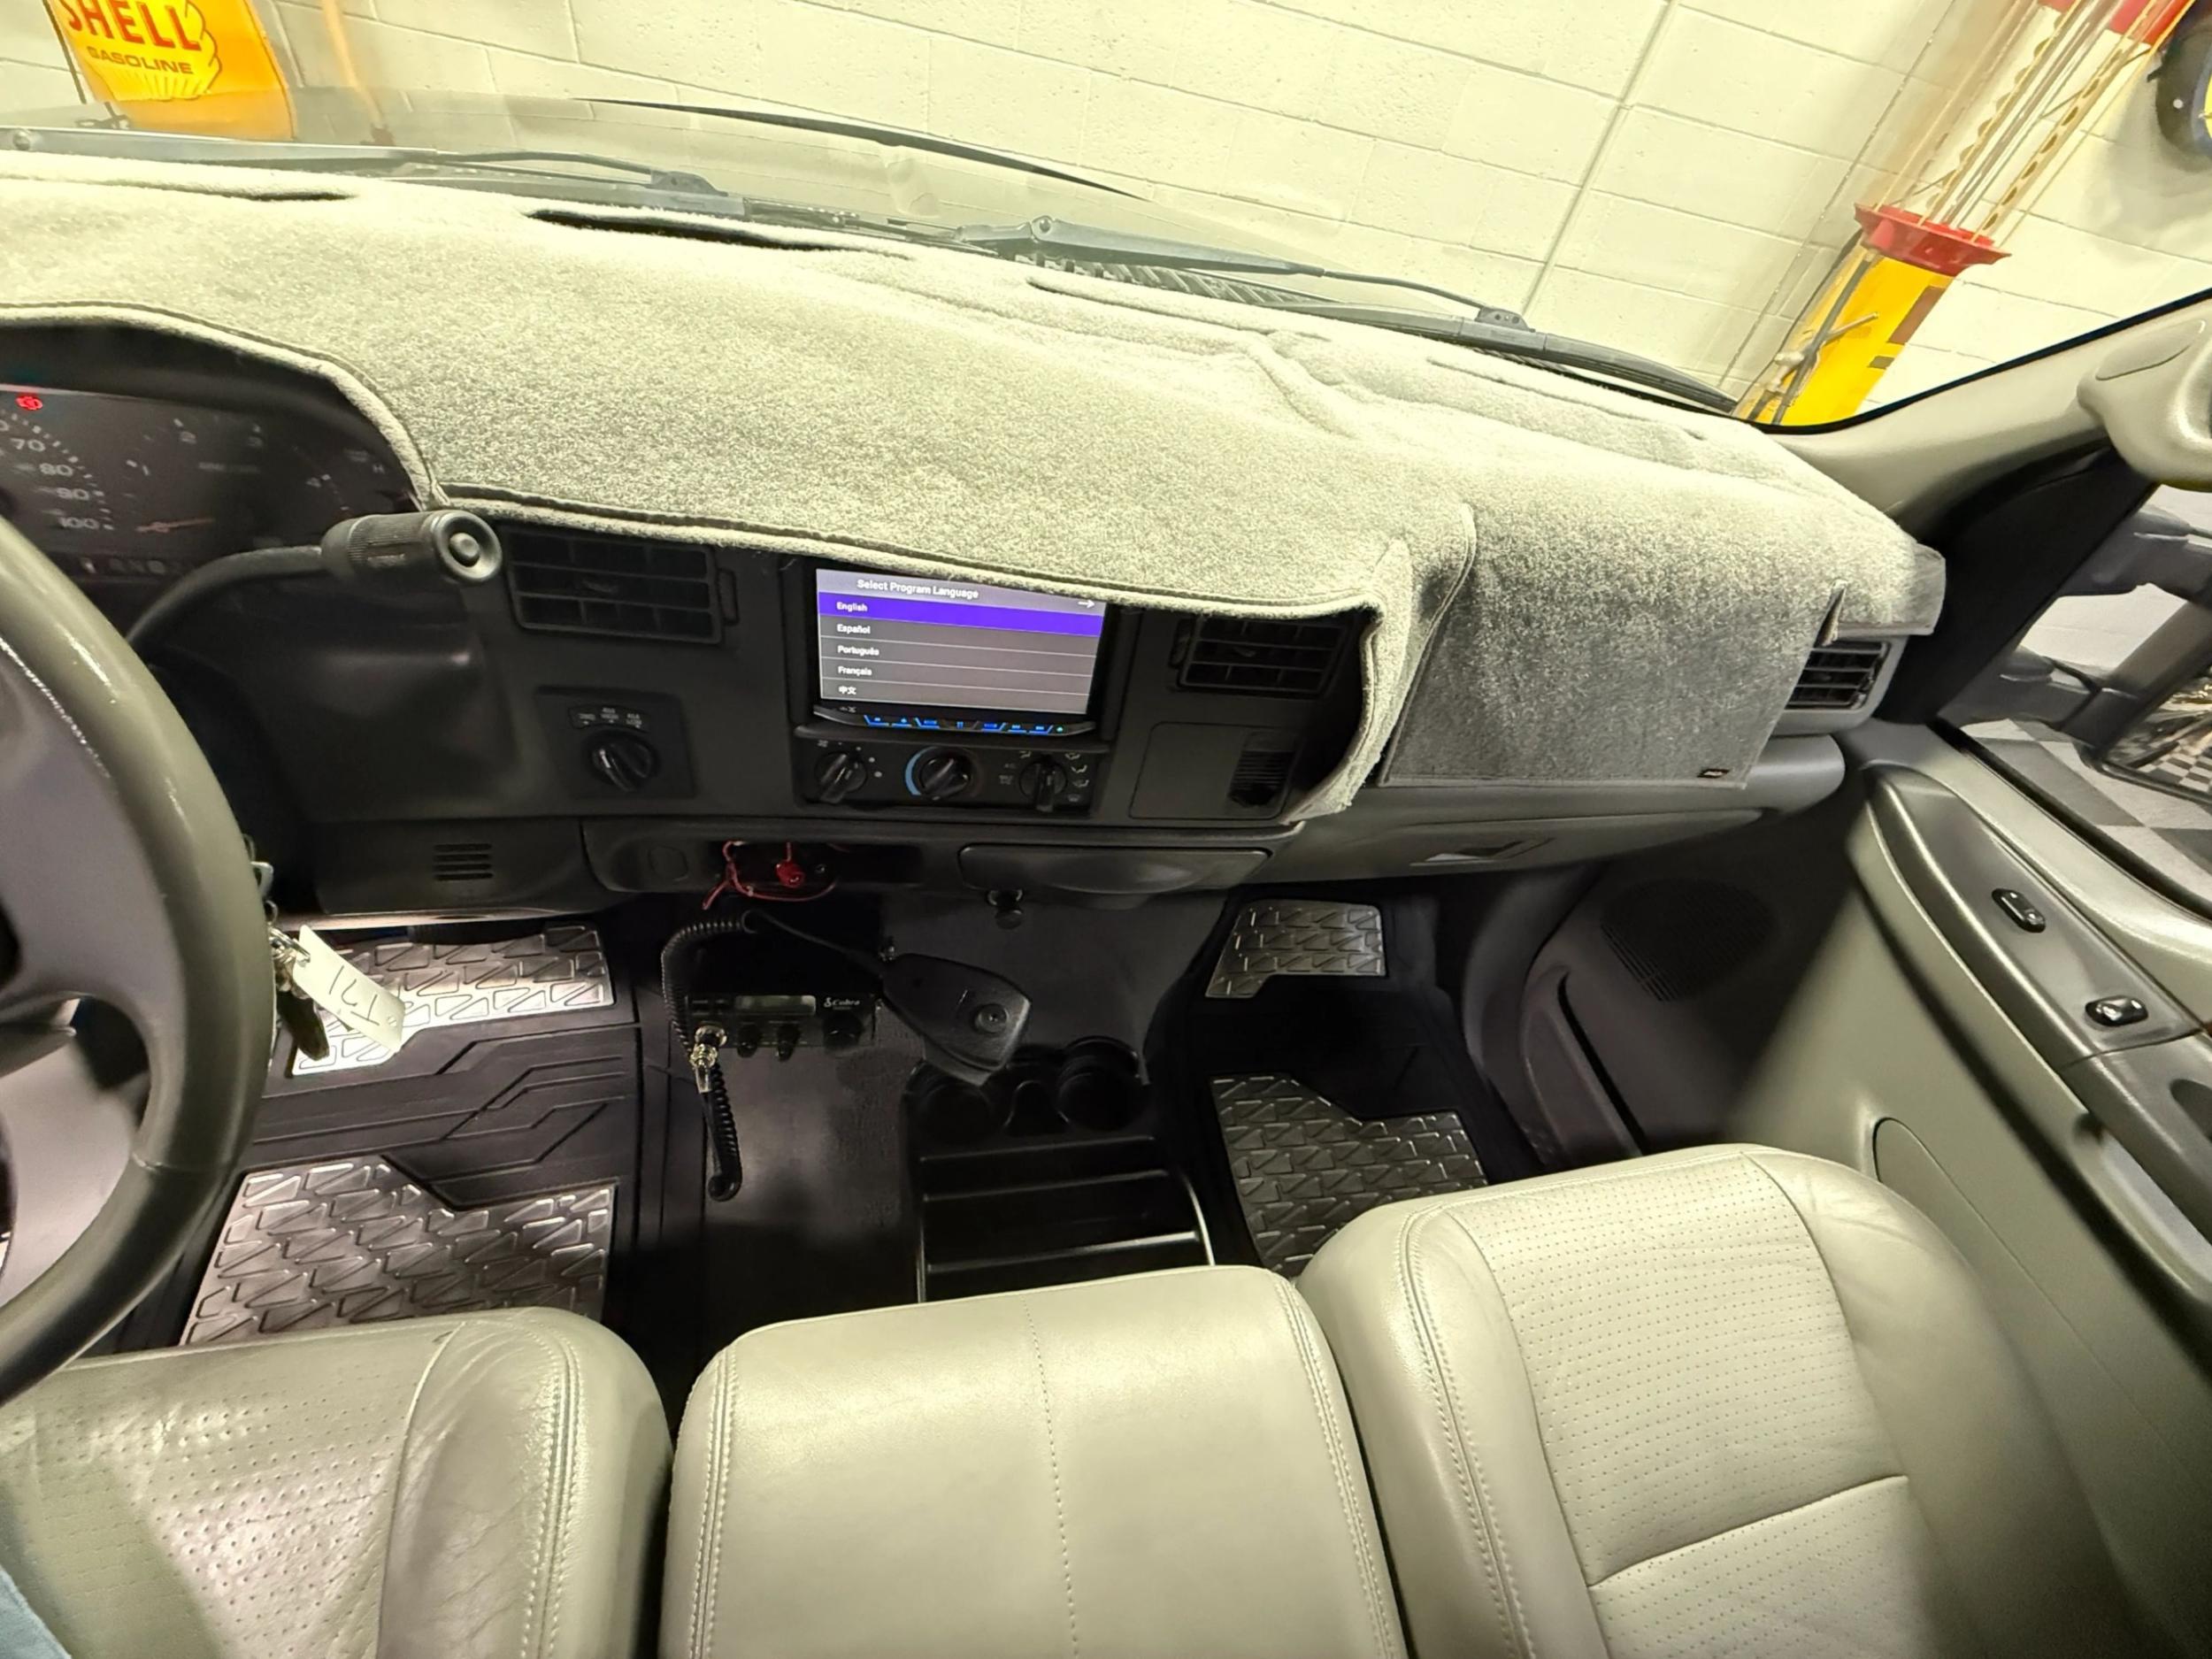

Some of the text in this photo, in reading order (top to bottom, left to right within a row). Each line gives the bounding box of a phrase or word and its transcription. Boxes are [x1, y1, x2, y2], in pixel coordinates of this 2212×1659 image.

[58, 0, 202, 51] SHELL
[87, 46, 193, 74] GASOLINE
[10, 438, 46, 452] 70
[39, 463, 73, 478] 80
[56, 488, 89, 501] 90
[59, 517, 100, 530] 100
[856, 579, 979, 600] Select Program Language
[836, 602, 868, 612] English
[837, 624, 871, 635] Español
[837, 645, 879, 657] Português
[838, 665, 872, 677] Français
